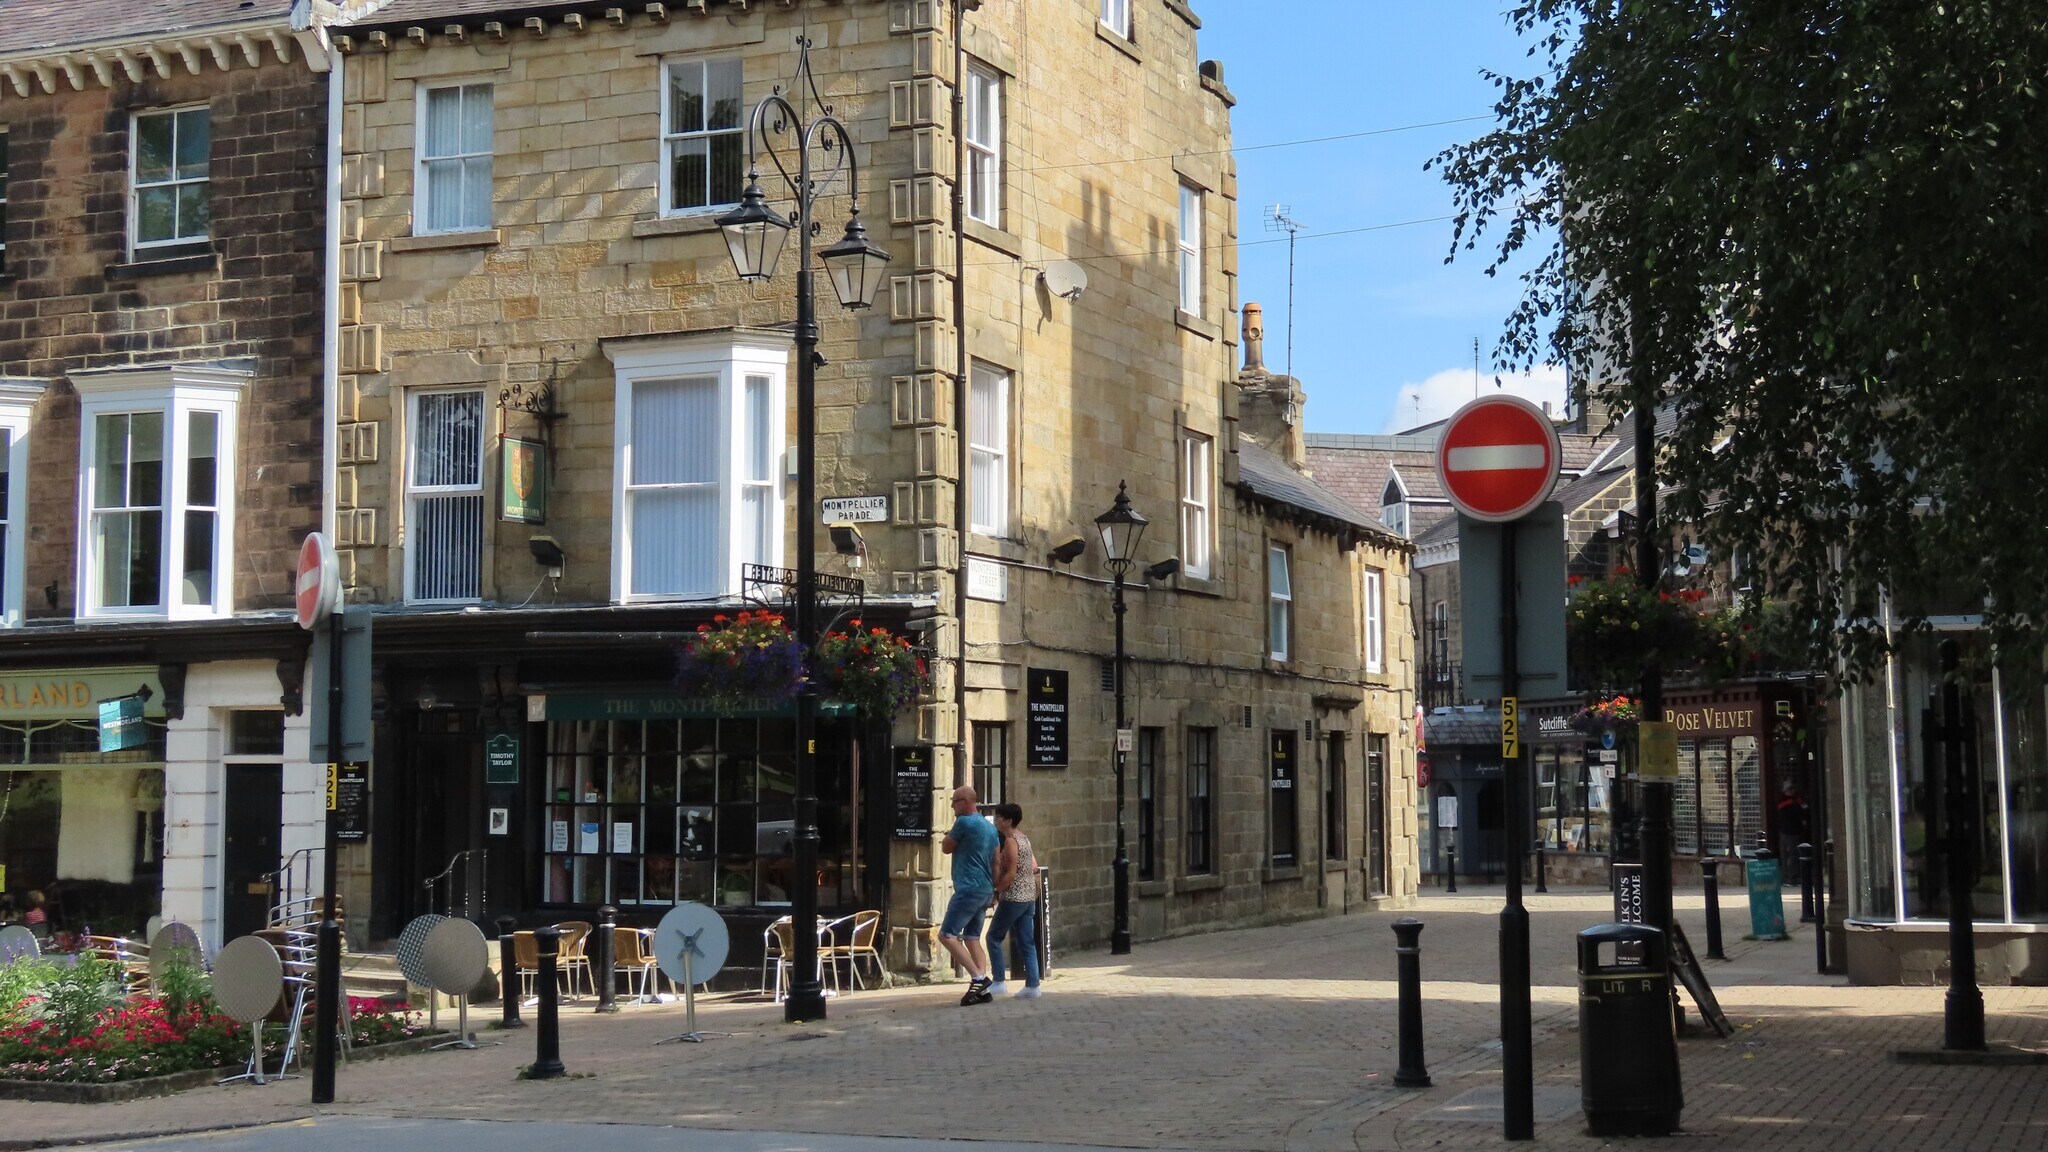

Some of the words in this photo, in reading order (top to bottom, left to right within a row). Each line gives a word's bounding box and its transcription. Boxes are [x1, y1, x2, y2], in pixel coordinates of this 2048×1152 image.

[824, 499, 884, 510] MONTPELLIER
[606, 699, 640, 714] THE
[1539, 715, 1567, 730] Sutcliffe
[1703, 707, 1753, 729] VELVET
[1621, 876, 1629, 902] IN'S
